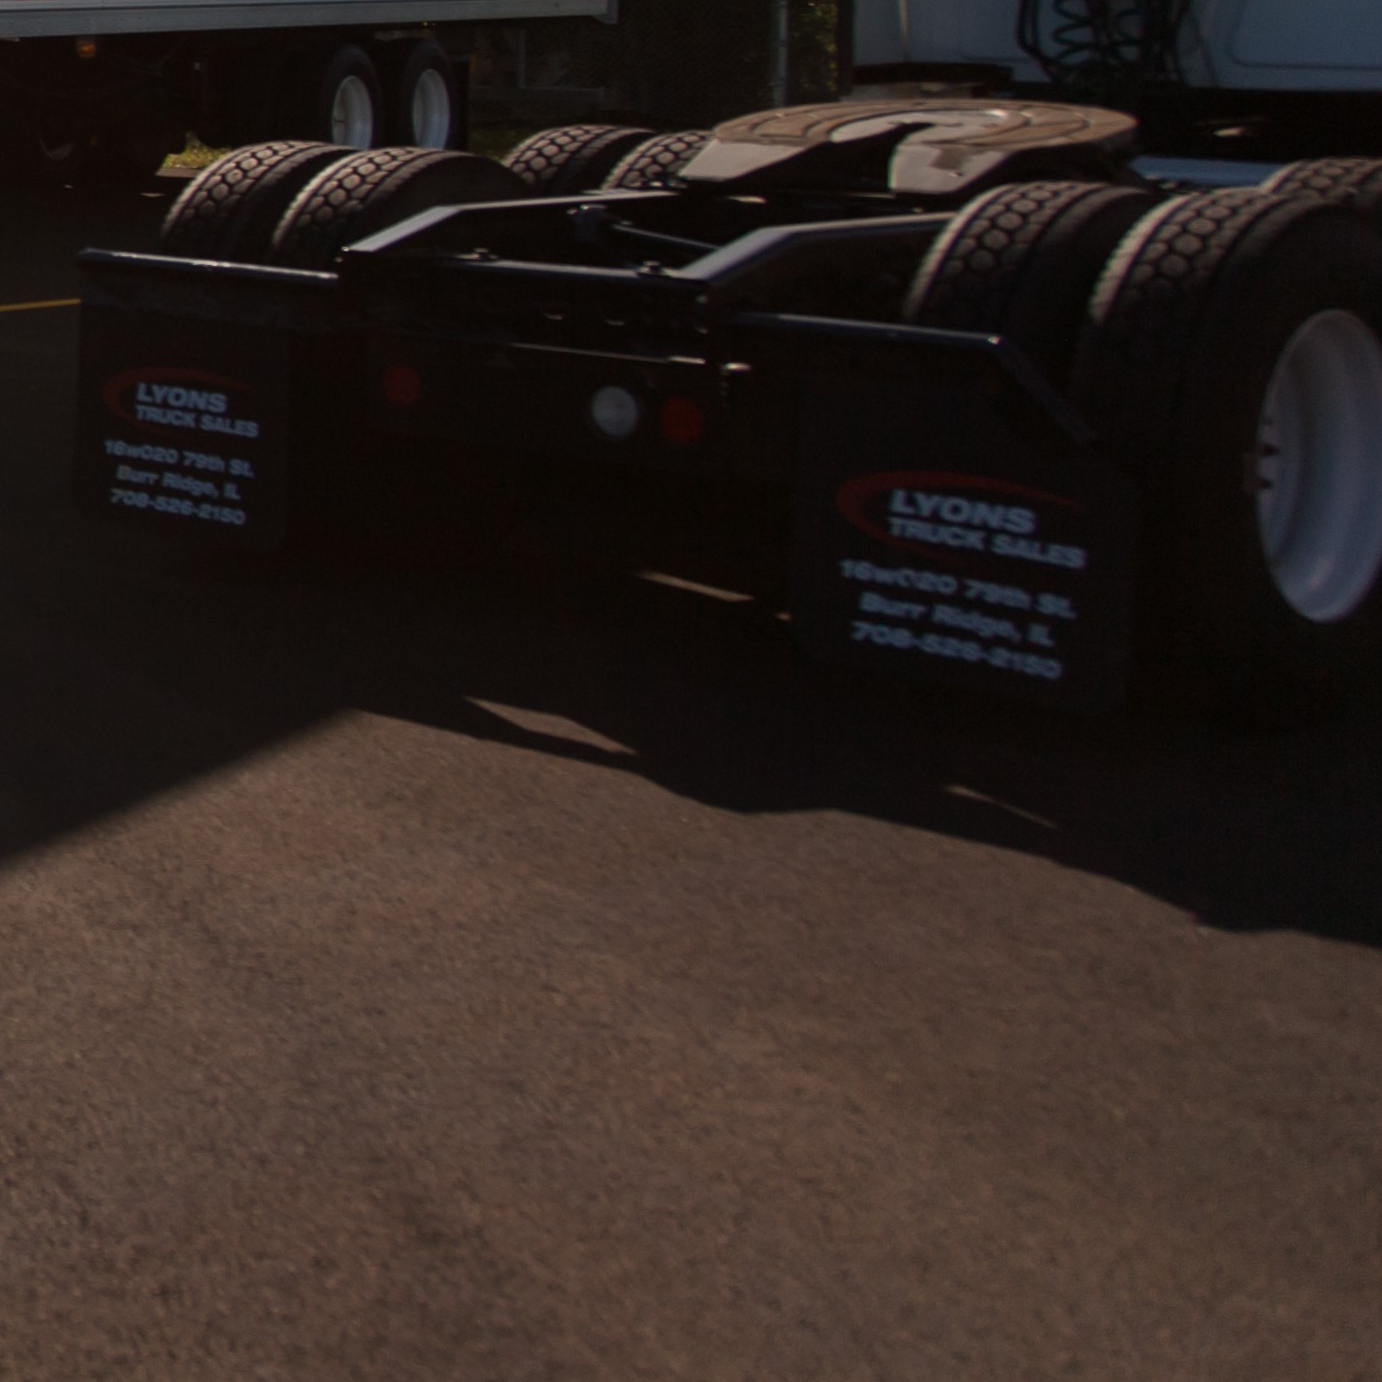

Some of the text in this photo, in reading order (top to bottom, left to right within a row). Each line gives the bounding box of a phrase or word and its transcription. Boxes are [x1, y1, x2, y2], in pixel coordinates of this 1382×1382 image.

[136, 382, 228, 413] LYONS
[135, 405, 260, 438] TRUCK SALES
[182, 451, 226, 473] 79th
[116, 464, 242, 500] Burr Ridge, IL
[888, 488, 1038, 535] LYONS
[886, 516, 1089, 570] TRUCK SALES
[858, 591, 1055, 647] Burr Ridge, IL
